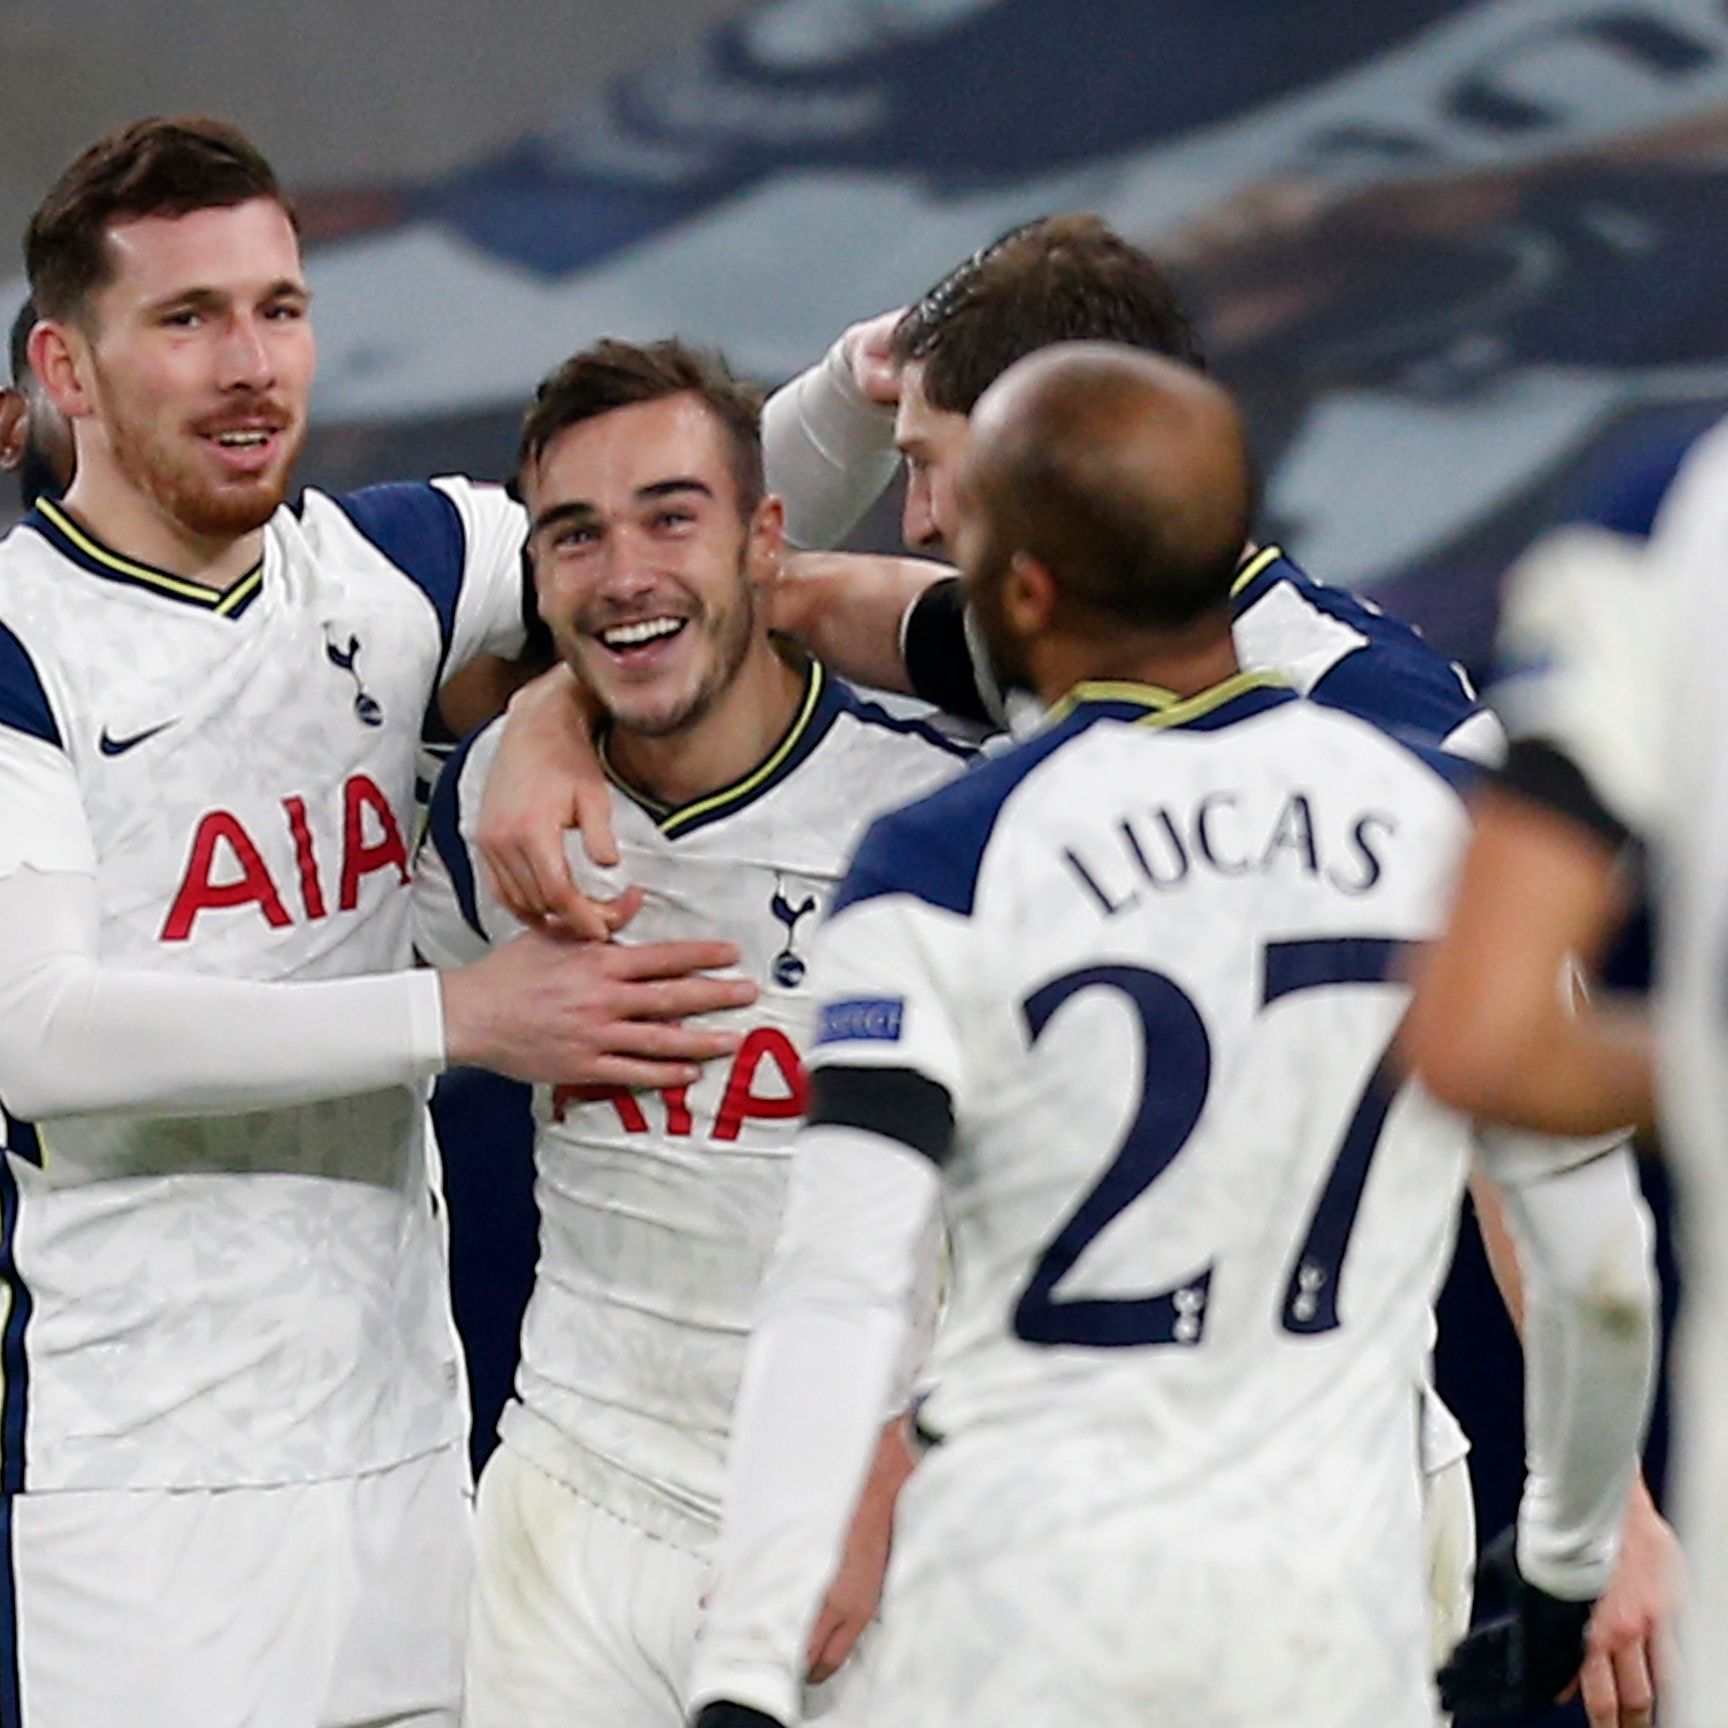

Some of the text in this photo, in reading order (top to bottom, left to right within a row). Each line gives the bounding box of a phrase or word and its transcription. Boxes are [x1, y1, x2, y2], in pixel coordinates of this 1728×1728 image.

[160, 774, 411, 941] AIA
[1062, 793, 1399, 917] LUCAS
[1012, 937, 1424, 1346] 27
